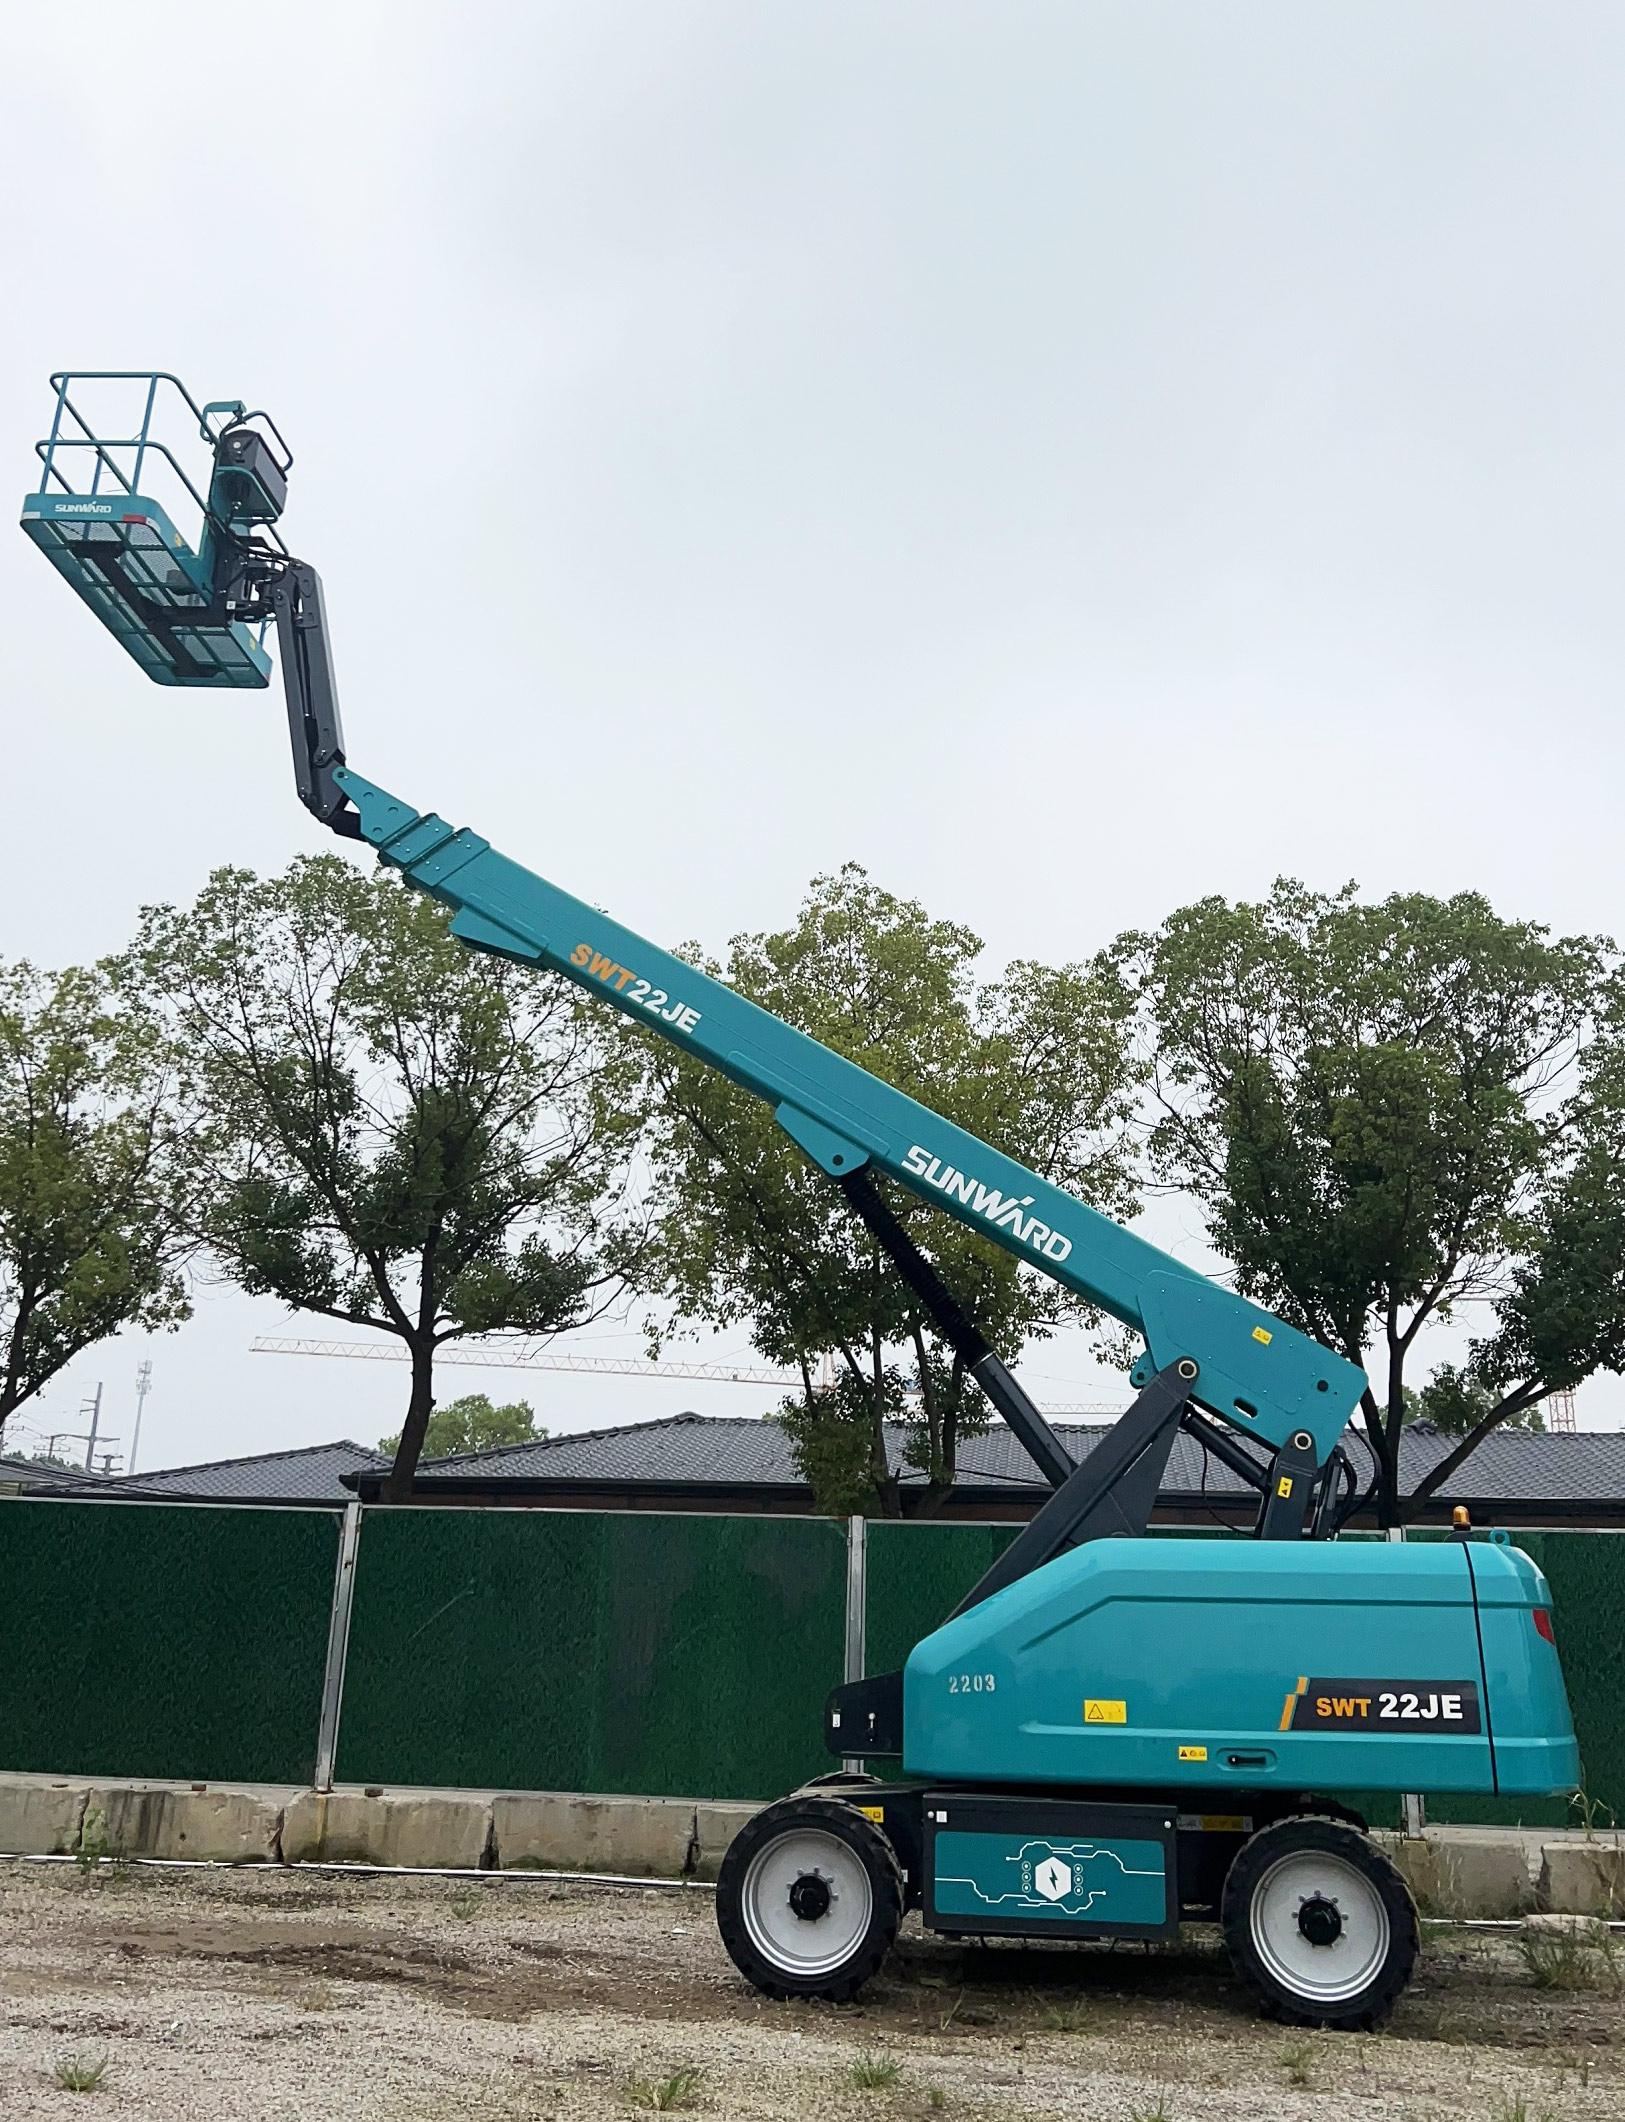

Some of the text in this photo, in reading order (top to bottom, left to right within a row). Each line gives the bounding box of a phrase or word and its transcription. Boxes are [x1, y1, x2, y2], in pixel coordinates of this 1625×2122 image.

[54, 501, 112, 513] SUNWARD
[901, 1144, 1073, 1262] SUNWARD
[949, 1674, 996, 1694] 2203
[1316, 1693, 1463, 1720] SWT 22JE
